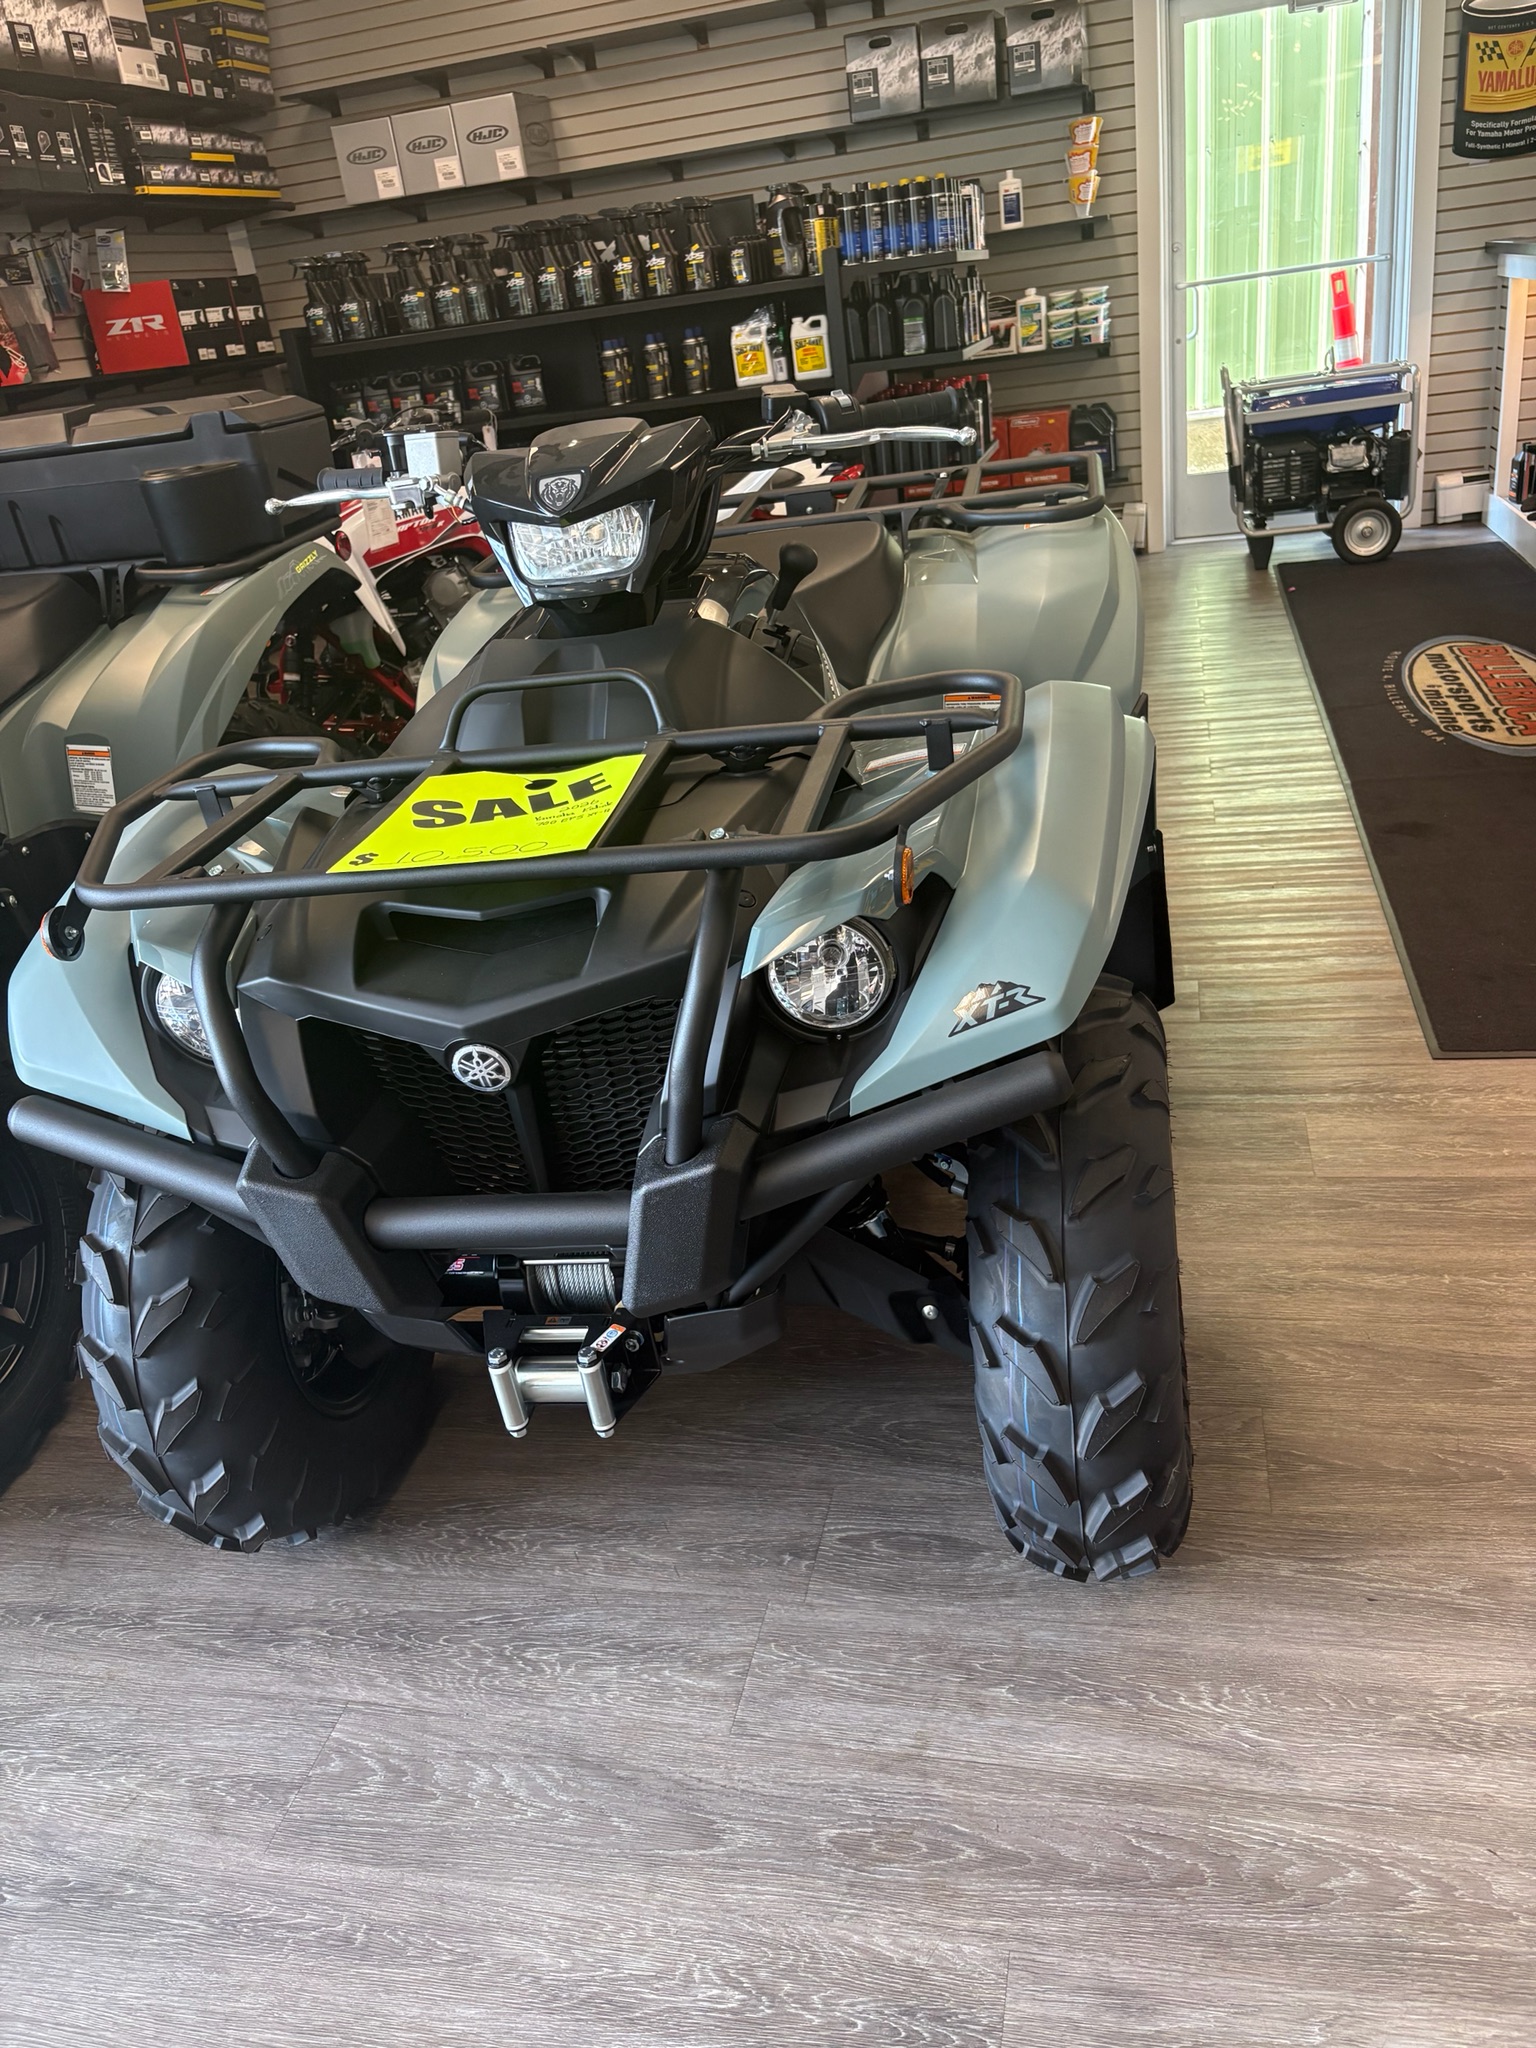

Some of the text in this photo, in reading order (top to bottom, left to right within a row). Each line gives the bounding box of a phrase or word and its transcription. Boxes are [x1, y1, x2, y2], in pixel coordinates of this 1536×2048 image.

[1478, 65, 1536, 92] YAMALU
[473, 128, 503, 141] HJC
[1466, 128, 1476, 136] For
[1477, 129, 1502, 138] Yamaha
[1503, 128, 1523, 137] Motor
[1471, 120, 1510, 129] Specifically
[352, 148, 382, 162] HJC
[412, 138, 442, 151] HJC
[105, 314, 167, 336] Z1R
[397, 514, 438, 532] APTOR
[295, 550, 318, 573] GRIZZLY
[1424, 653, 1496, 733] motorsports
[1422, 689, 1464, 732] marine
[411, 772, 613, 829] SALE
[349, 841, 548, 866] $ 10,500
[953, 985, 1040, 1033] XT-R
